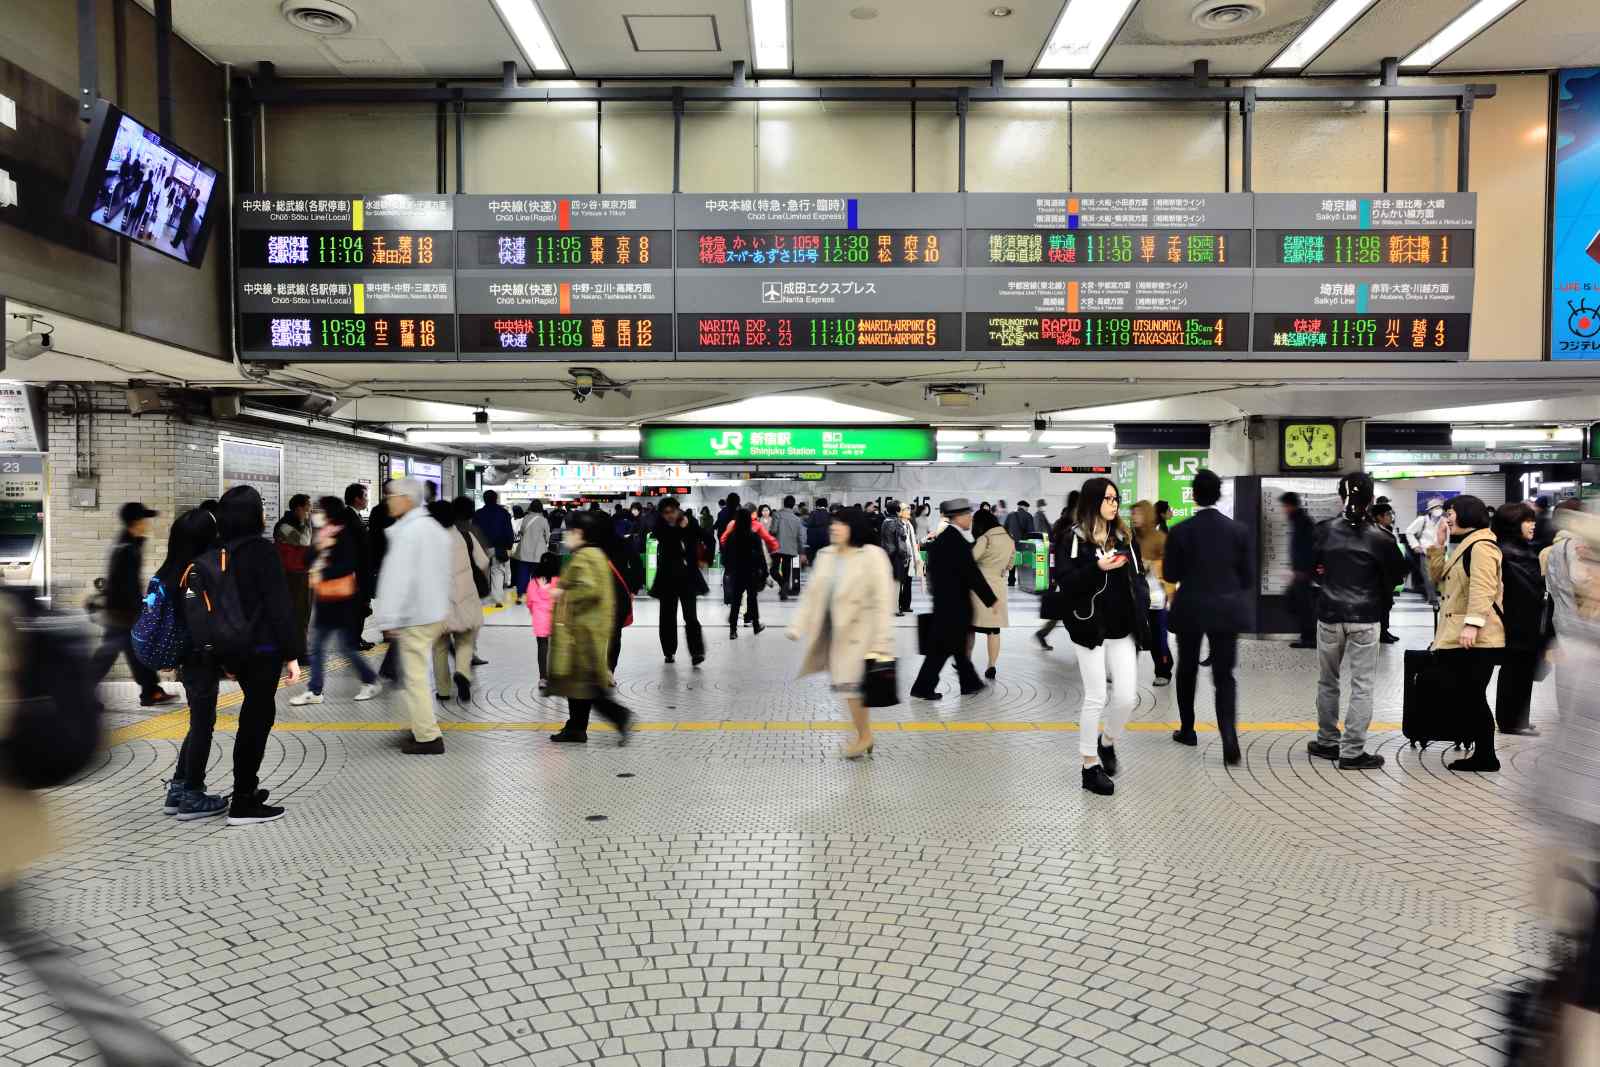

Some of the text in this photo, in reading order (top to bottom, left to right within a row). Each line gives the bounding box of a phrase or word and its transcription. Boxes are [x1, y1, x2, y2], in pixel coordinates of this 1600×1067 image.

[489, 200, 557, 213] 中央線(快速)
[1321, 200, 1358, 212] 埼京線
[1342, 213, 1358, 221] Line
[1372, 209, 1434, 219] りんかい線方面
[268, 236, 309, 250] 各駅停車
[319, 237, 363, 250] 11:04
[418, 237, 433, 249] 13
[499, 236, 526, 250] 快速
[536, 237, 581, 250] 11:05
[639, 237, 649, 250] 8
[699, 236, 726, 250] 特急
[823, 236, 869, 250] 11:30
[927, 236, 938, 249] 9
[1049, 235, 1076, 249] 普通
[1087, 236, 1132, 249] 11:15
[1217, 236, 1225, 249] 1
[1284, 236, 1448, 250] 各駅停車 11:06 新木場 1
[268, 250, 433, 264] 各駅停車 11:10 津田沼 13
[499, 250, 526, 264] 快速
[536, 251, 581, 264] 11:10
[639, 251, 649, 264] 8
[699, 250, 726, 264] 特急
[823, 250, 869, 263] 12:00
[924, 250, 940, 263] 10
[1048, 250, 1076, 263] 快速
[1087, 250, 1132, 263] 11:30
[1217, 250, 1225, 263] 1
[1284, 250, 1448, 264] 各駅停車 11:26 新木場 1
[489, 283, 558, 297] 中央線(快速)
[782, 282, 877, 295] 成田エクスプレス
[1319, 284, 1356, 296] 埼京線
[782, 296, 836, 305] Narita Express
[1341, 297, 1356, 305] Line
[271, 319, 311, 333] 各駅停車
[321, 319, 366, 332] 10:59
[419, 320, 435, 332] 16
[494, 320, 534, 333] 中央特快
[538, 320, 582, 333] 11:07
[637, 320, 652, 333] 12
[699, 320, 740, 332] NARITA
[746, 320, 771, 332] EXP.
[778, 320, 792, 332] 21
[809, 320, 855, 332] 11:10
[926, 319, 936, 332] 6
[1041, 319, 1082, 332] RAPID
[1086, 319, 1130, 332] 11:09
[1133, 319, 1182, 332] UTSUNOMIYA
[1214, 319, 1224, 332] 4
[1293, 319, 1322, 333] 快速
[1331, 320, 1377, 333] 11:05
[1435, 320, 1445, 333] 4
[271, 333, 312, 347] 各駅停車
[321, 333, 366, 346] 11:04
[419, 333, 435, 346] 16
[500, 334, 528, 347] 快速
[538, 334, 582, 347] 11:09
[637, 334, 652, 347] 12
[699, 333, 740, 345] NARITA
[746, 333, 771, 345] EXP.
[778, 333, 792, 345] 23
[809, 333, 855, 345] 11:40
[926, 333, 936, 345] 5
[1057, 338, 1081, 346] RAPID
[1086, 333, 1130, 345] 11:19
[1133, 333, 1184, 345] TAKASAKI
[1214, 333, 1224, 345] 4
[1331, 334, 1376, 346] 11:11
[1434, 334, 1445, 346] 3
[710, 431, 744, 450] JR
[751, 447, 785, 457] Shinjuku
[787, 447, 816, 456] Station
[3, 463, 20, 473] 23
[1168, 457, 1199, 475] JR
